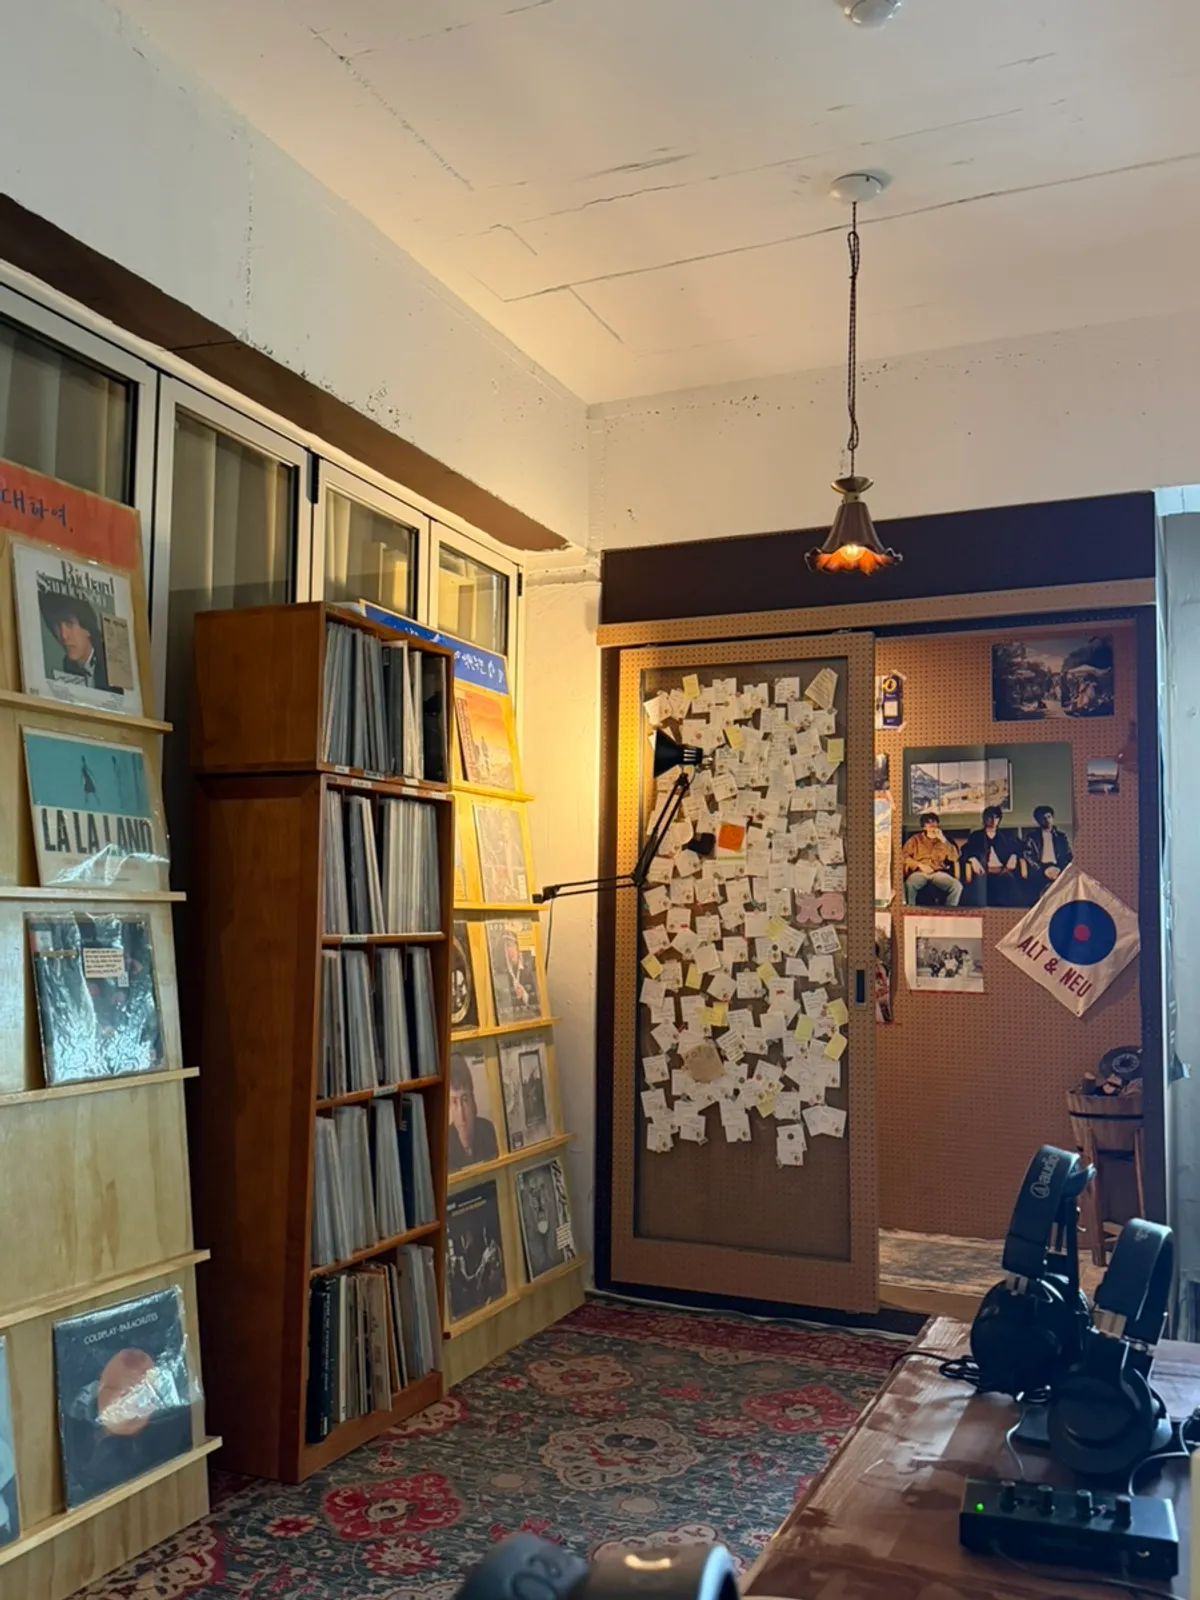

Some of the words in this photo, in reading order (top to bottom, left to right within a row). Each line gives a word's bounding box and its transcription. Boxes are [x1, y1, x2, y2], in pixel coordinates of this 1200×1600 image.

[42, 808, 71, 852] LA
[73, 811, 100, 853] LA
[103, 815, 154, 856] LAND
[1017, 935, 1048, 961] ALT
[1043, 957, 1059, 976] &
[1059, 967, 1093, 998] NEU
[83, 1327, 118, 1345] COLDPLAY
